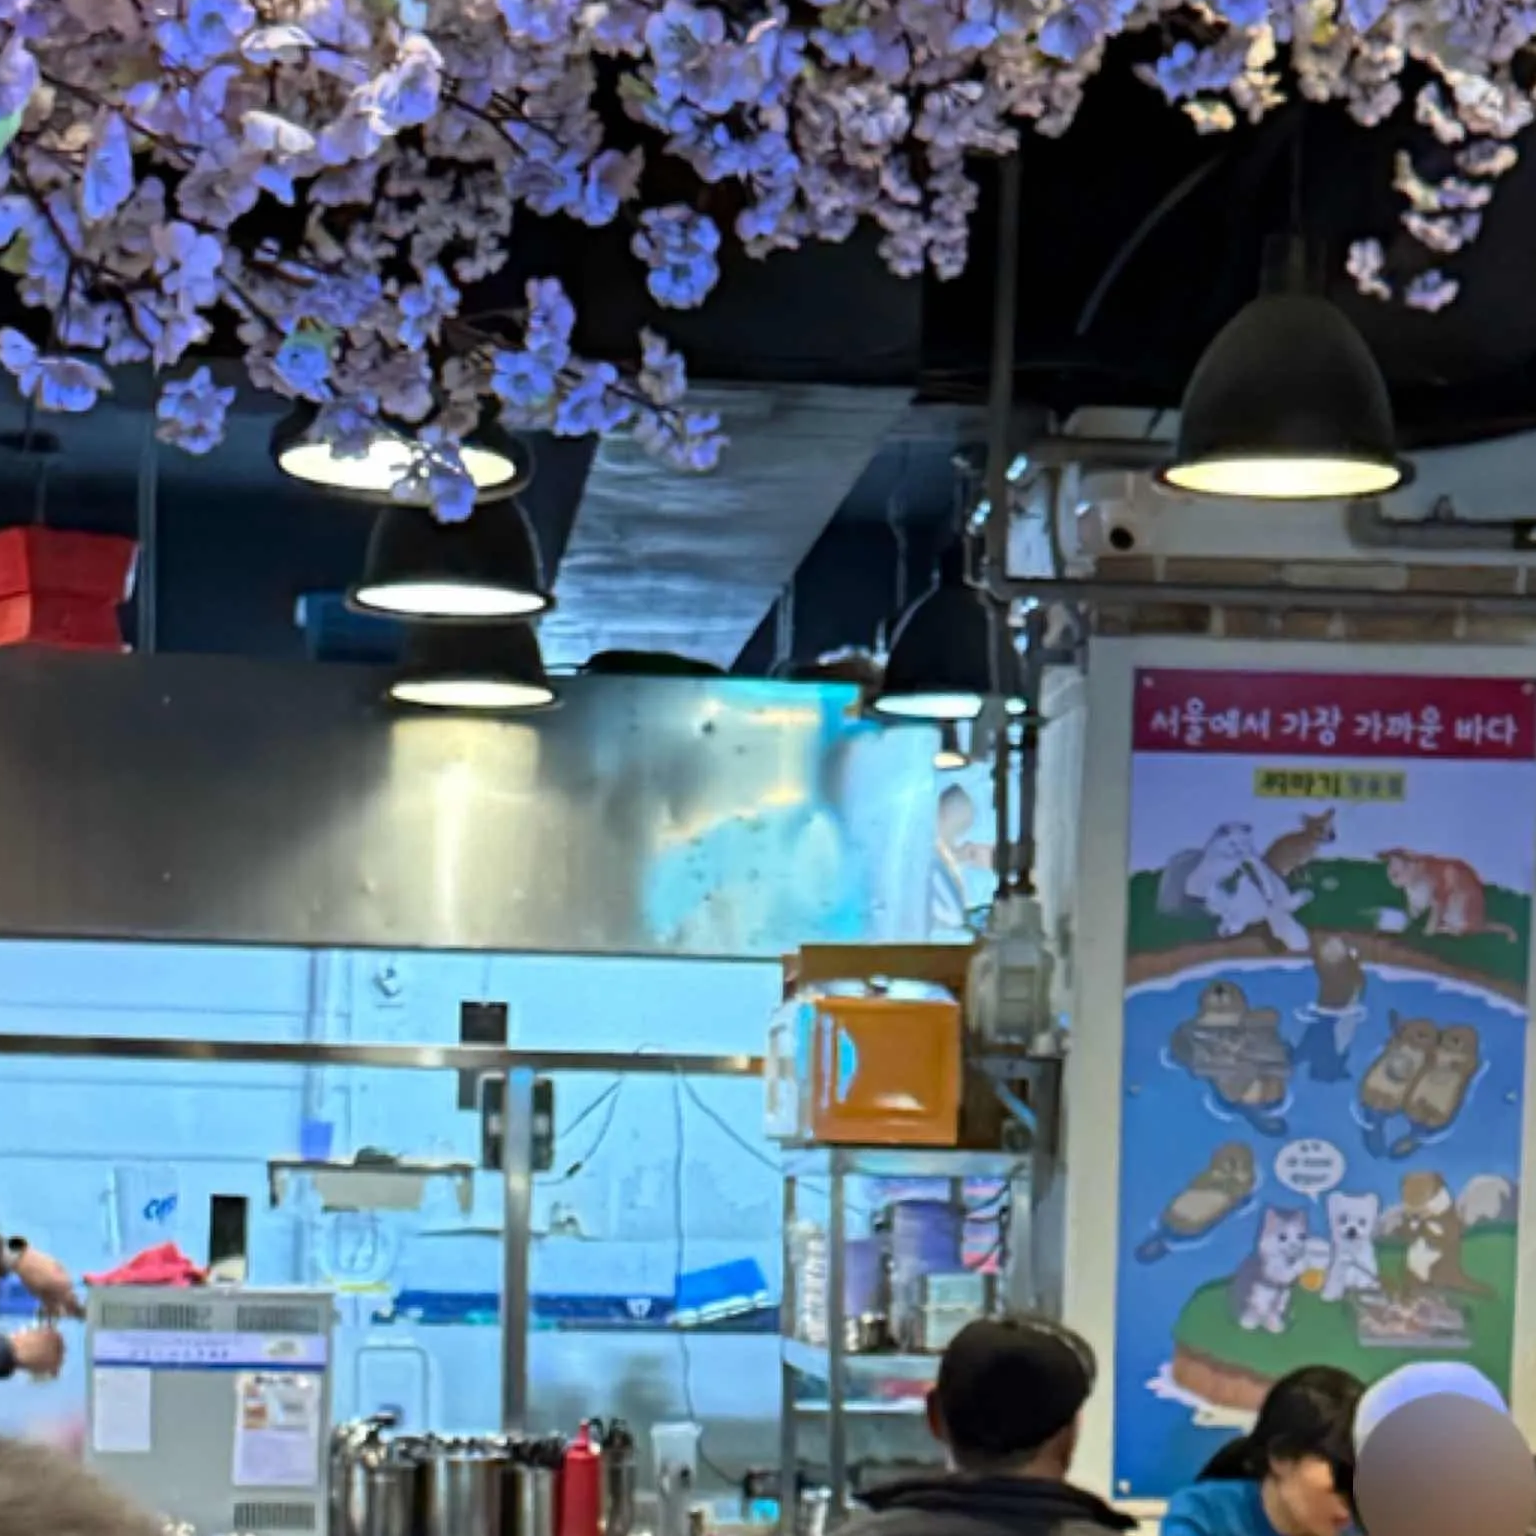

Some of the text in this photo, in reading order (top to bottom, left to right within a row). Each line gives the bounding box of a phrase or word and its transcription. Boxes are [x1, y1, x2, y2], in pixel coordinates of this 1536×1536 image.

[1150, 697, 1519, 750] 서울에서 가장 가까운 바다
